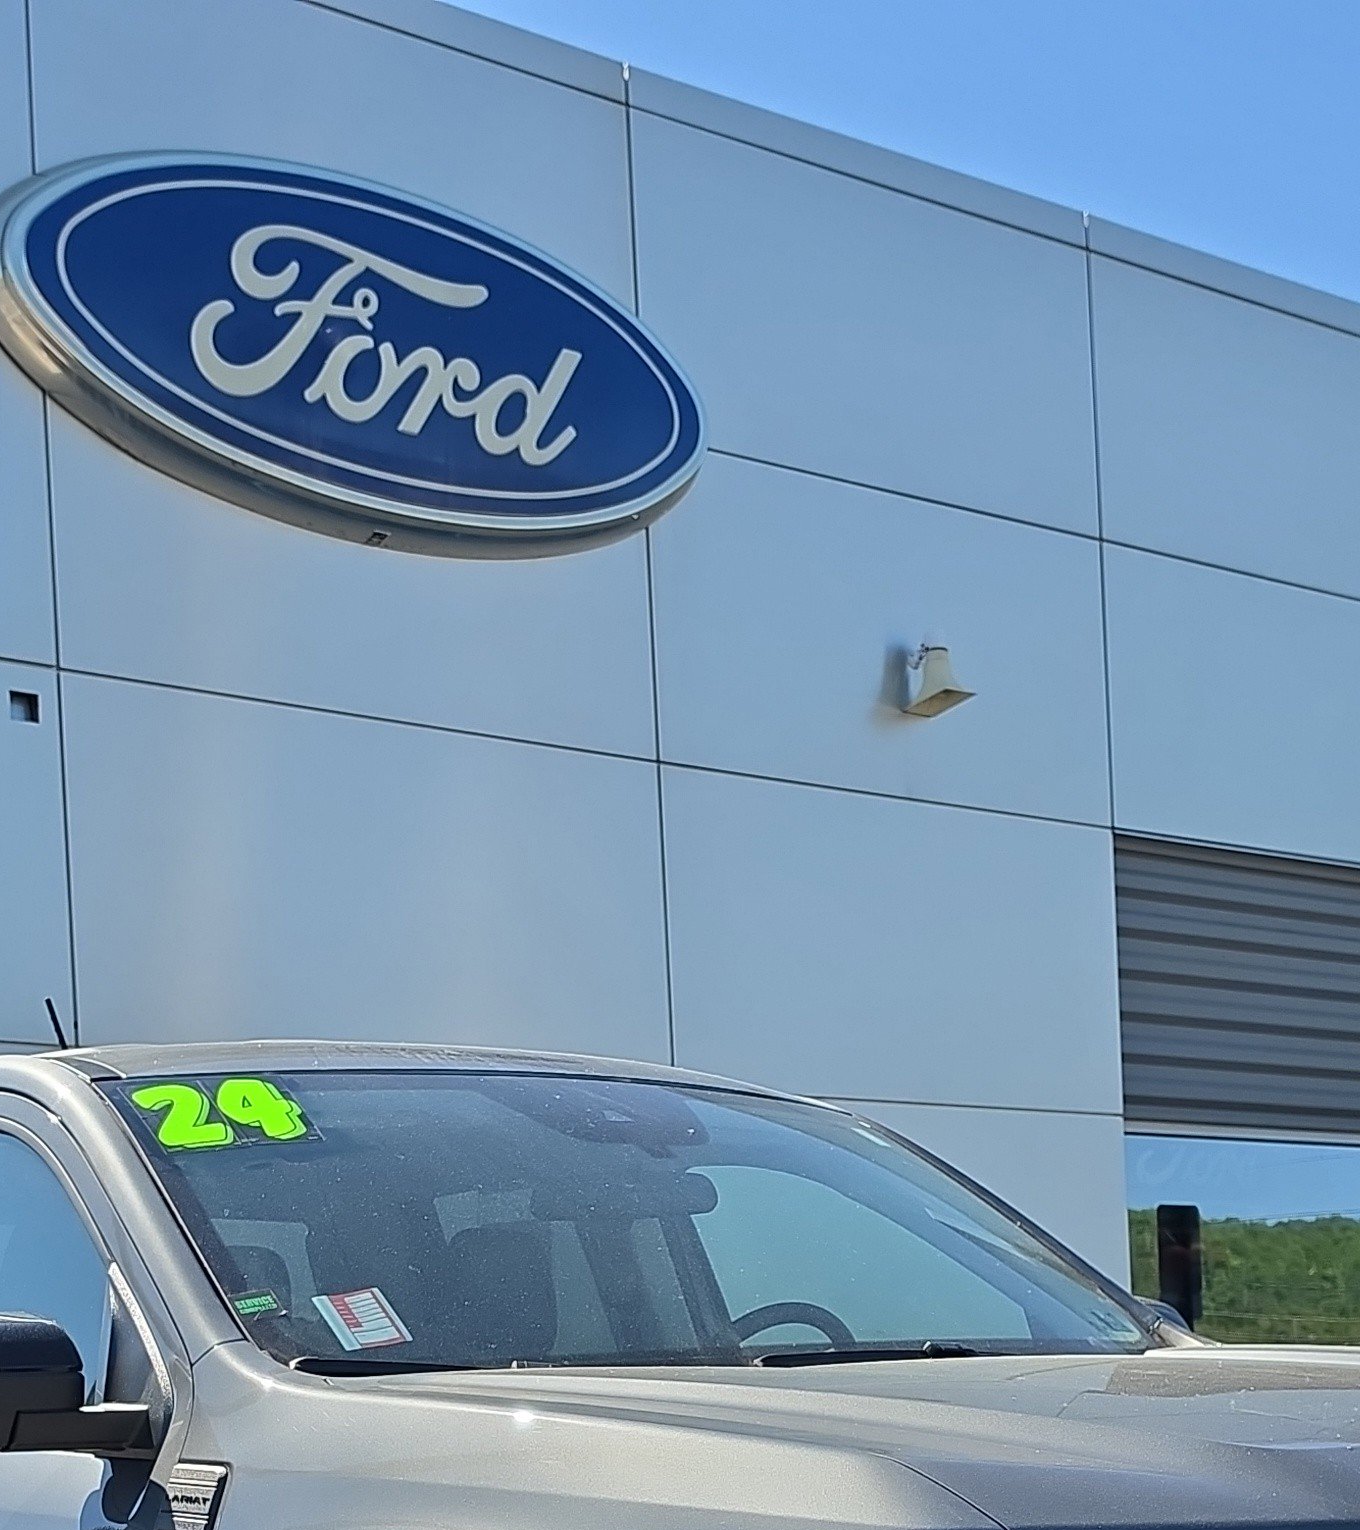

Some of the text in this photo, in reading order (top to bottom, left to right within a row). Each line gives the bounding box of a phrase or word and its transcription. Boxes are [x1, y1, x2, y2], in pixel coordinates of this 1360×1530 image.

[190, 224, 582, 465] Ford
[131, 1078, 308, 1148] 24
[170, 1495, 211, 1506] ARIAT
